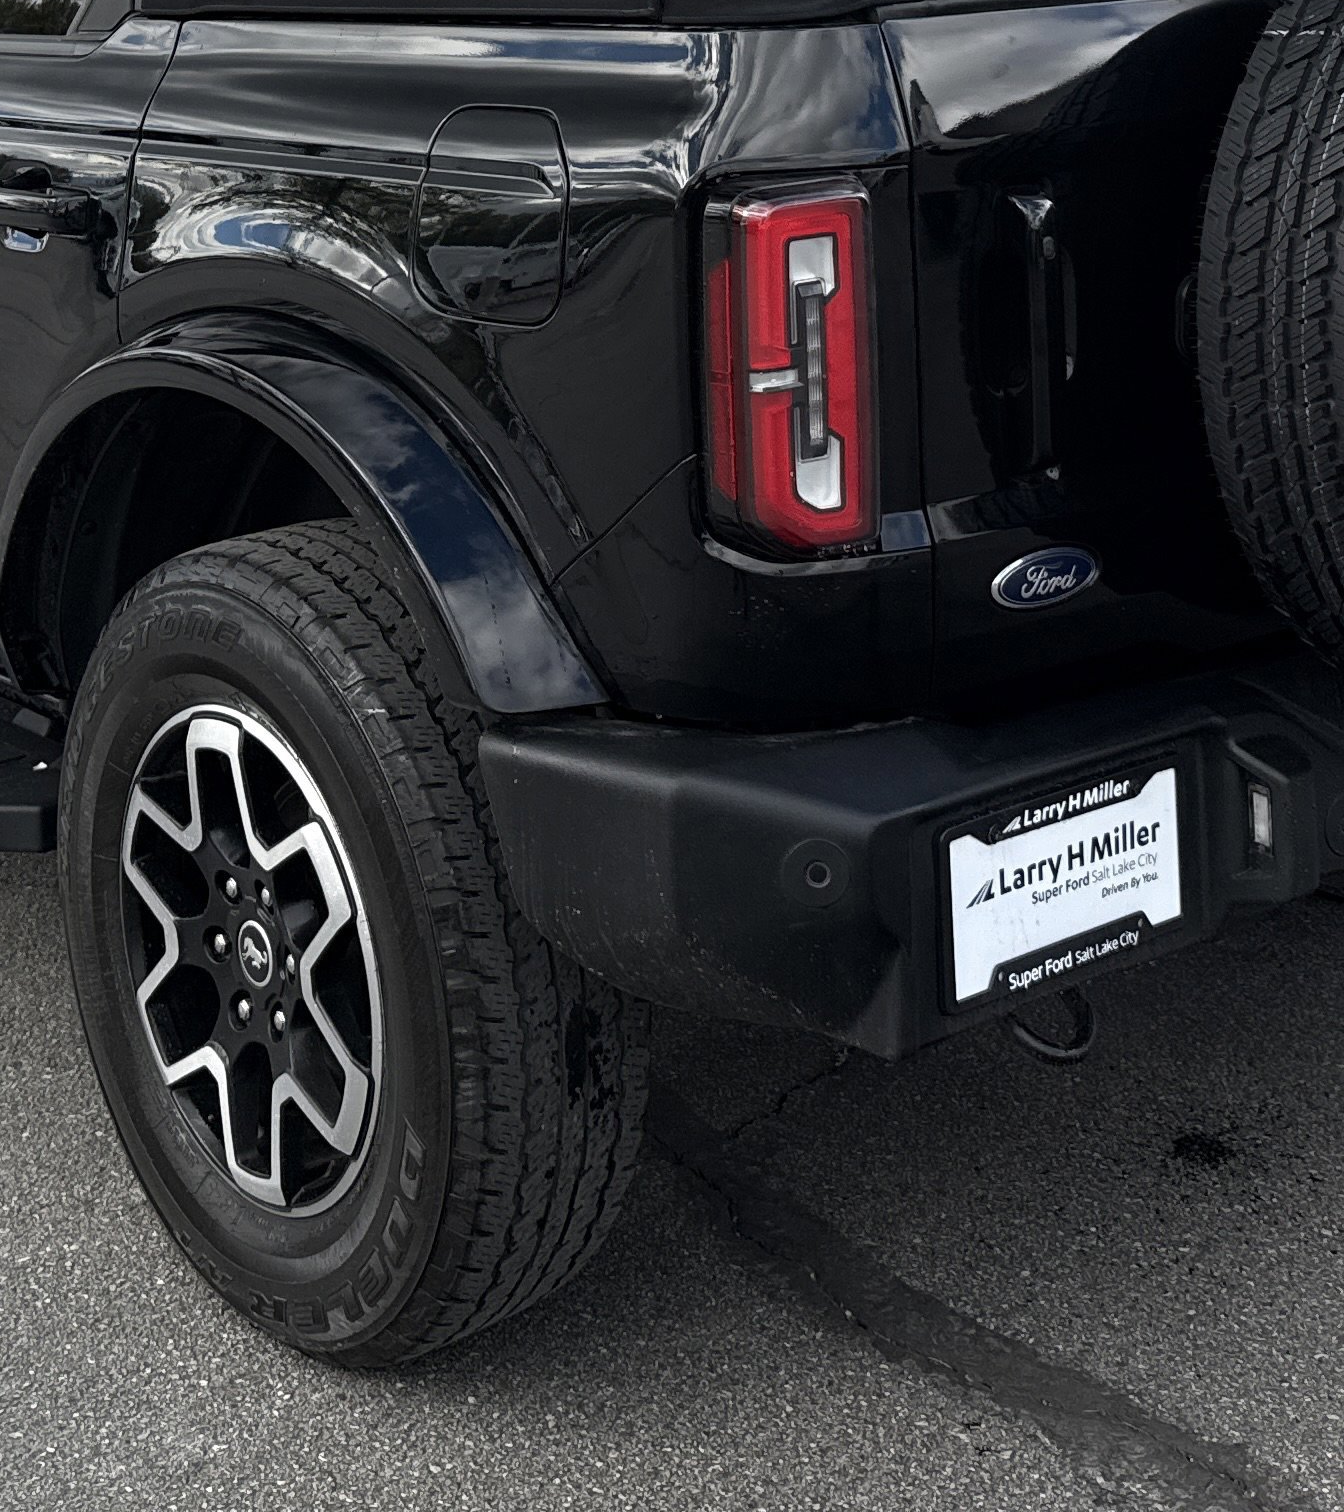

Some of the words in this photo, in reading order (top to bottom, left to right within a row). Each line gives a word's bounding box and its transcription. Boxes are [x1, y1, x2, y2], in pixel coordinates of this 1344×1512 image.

[1020, 561, 1077, 599] Ford
[1023, 799, 1066, 827] Larry
[1067, 792, 1081, 813] H
[1082, 779, 1130, 809] Miller
[999, 852, 1062, 896] Larry
[1066, 840, 1085, 871] H
[1089, 820, 1161, 864] Miller
[1031, 884, 1063, 905] Super
[1065, 872, 1090, 893] Ford
[1091, 864, 1111, 884] Salt
[1112, 856, 1136, 877] Lake
[1137, 851, 1158, 872] City
[1101, 879, 1129, 898] Driven
[1130, 875, 1142, 890] By
[1008, 966, 1043, 990] Super
[1045, 951, 1073, 977] Ford
[1075, 946, 1094, 965] Salt
[1096, 937, 1119, 957] Lake
[1119, 930, 1139, 949] City
